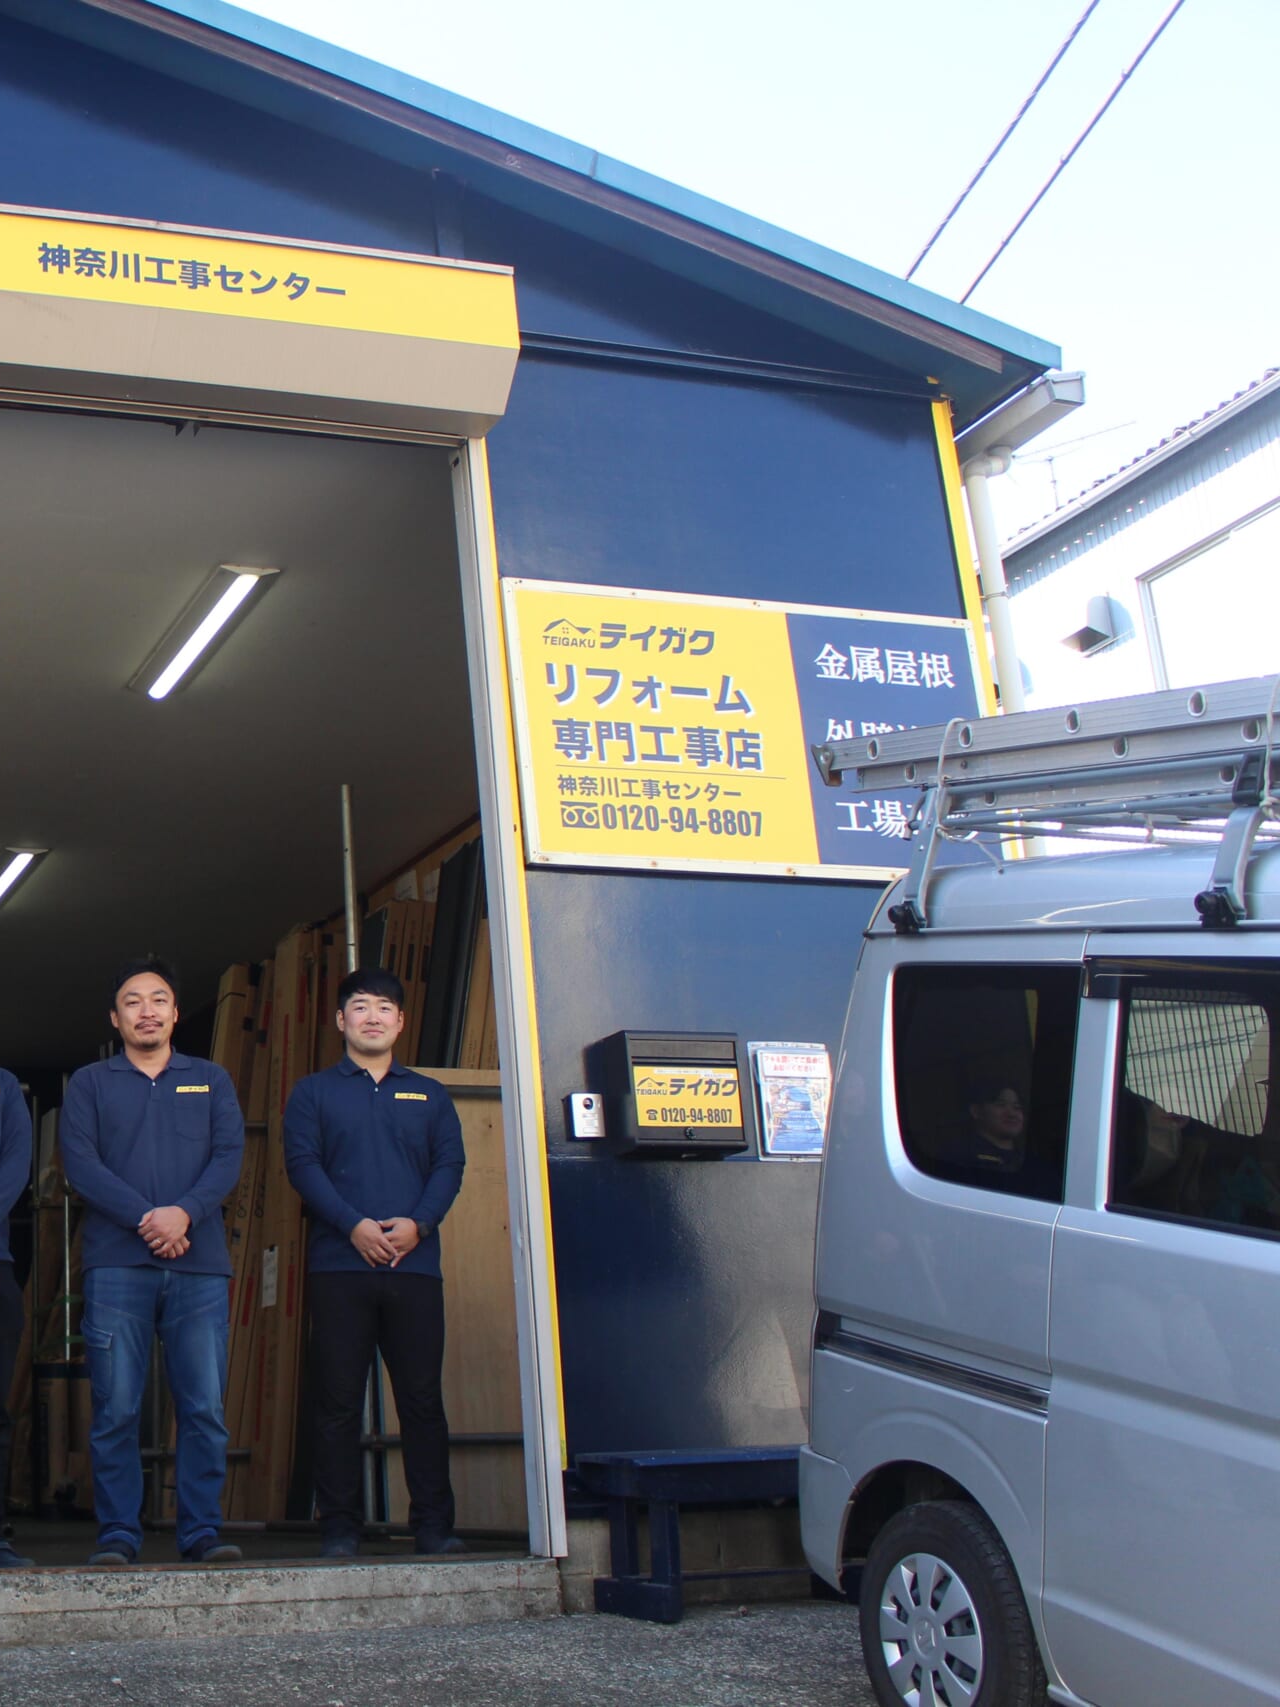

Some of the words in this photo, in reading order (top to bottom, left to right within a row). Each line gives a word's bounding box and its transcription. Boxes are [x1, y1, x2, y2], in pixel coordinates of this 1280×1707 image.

[38, 241, 347, 301] 神奈川工事センター
[542, 635, 596, 649] TEIGAKU
[599, 622, 716, 657] テイガク
[814, 643, 956, 689] 金属屋根
[544, 661, 755, 716] リフォーム
[551, 717, 764, 772] 専門工事店
[557, 774, 742, 803] 神奈川工事センター
[601, 803, 763, 838] 0120-94-8807
[835, 799, 924, 839] 工場
[669, 1078, 737, 1096] テイガク
[661, 1107, 733, 1123] 0120-94-8807
